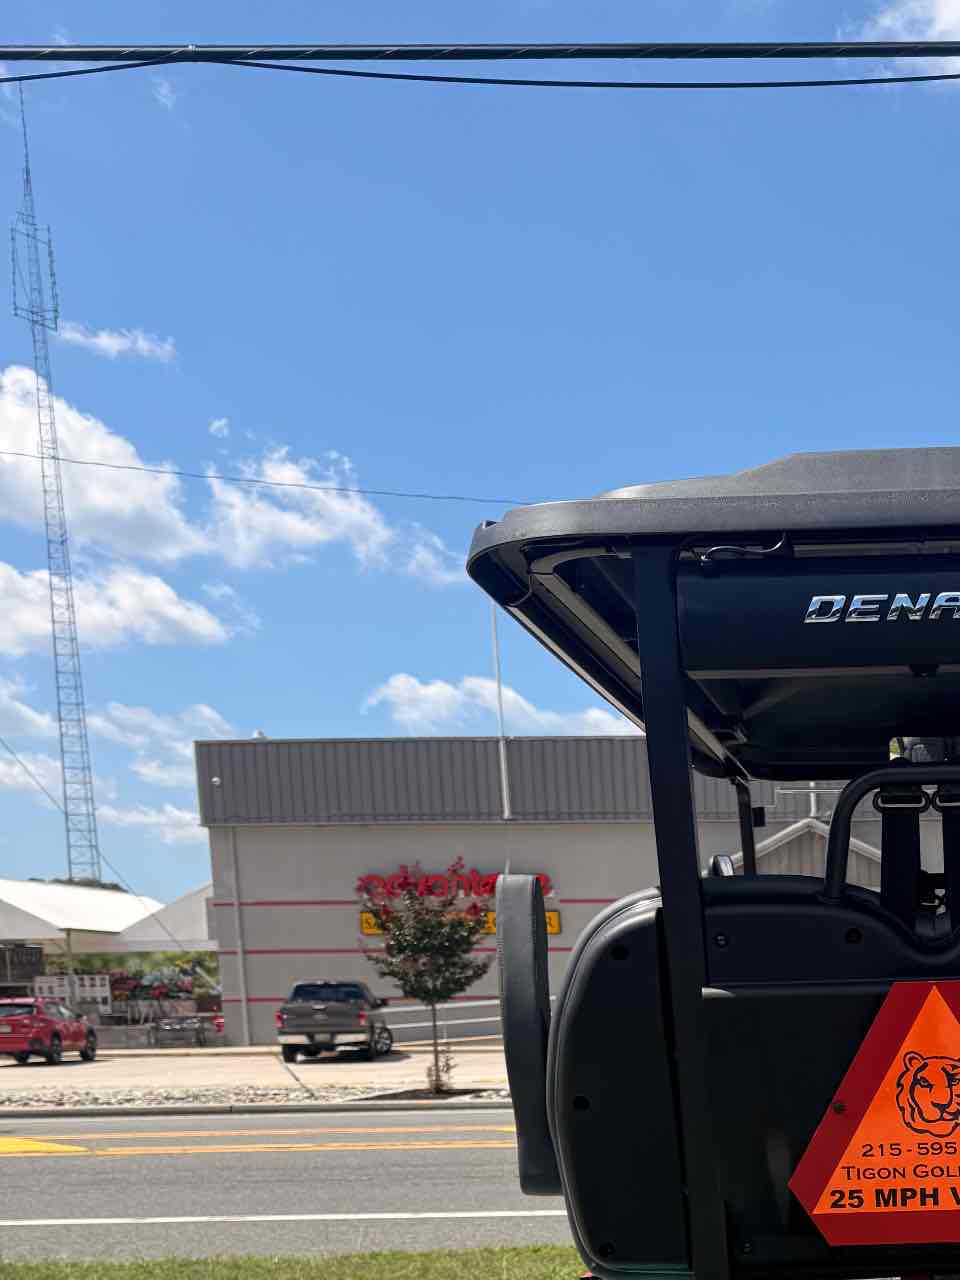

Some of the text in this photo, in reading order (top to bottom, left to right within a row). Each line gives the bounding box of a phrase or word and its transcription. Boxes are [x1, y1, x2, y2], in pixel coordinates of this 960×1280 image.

[841, 1165, 906, 1181] TIGON
[829, 1189, 864, 1209] 25
[874, 1187, 939, 1208] MPH
